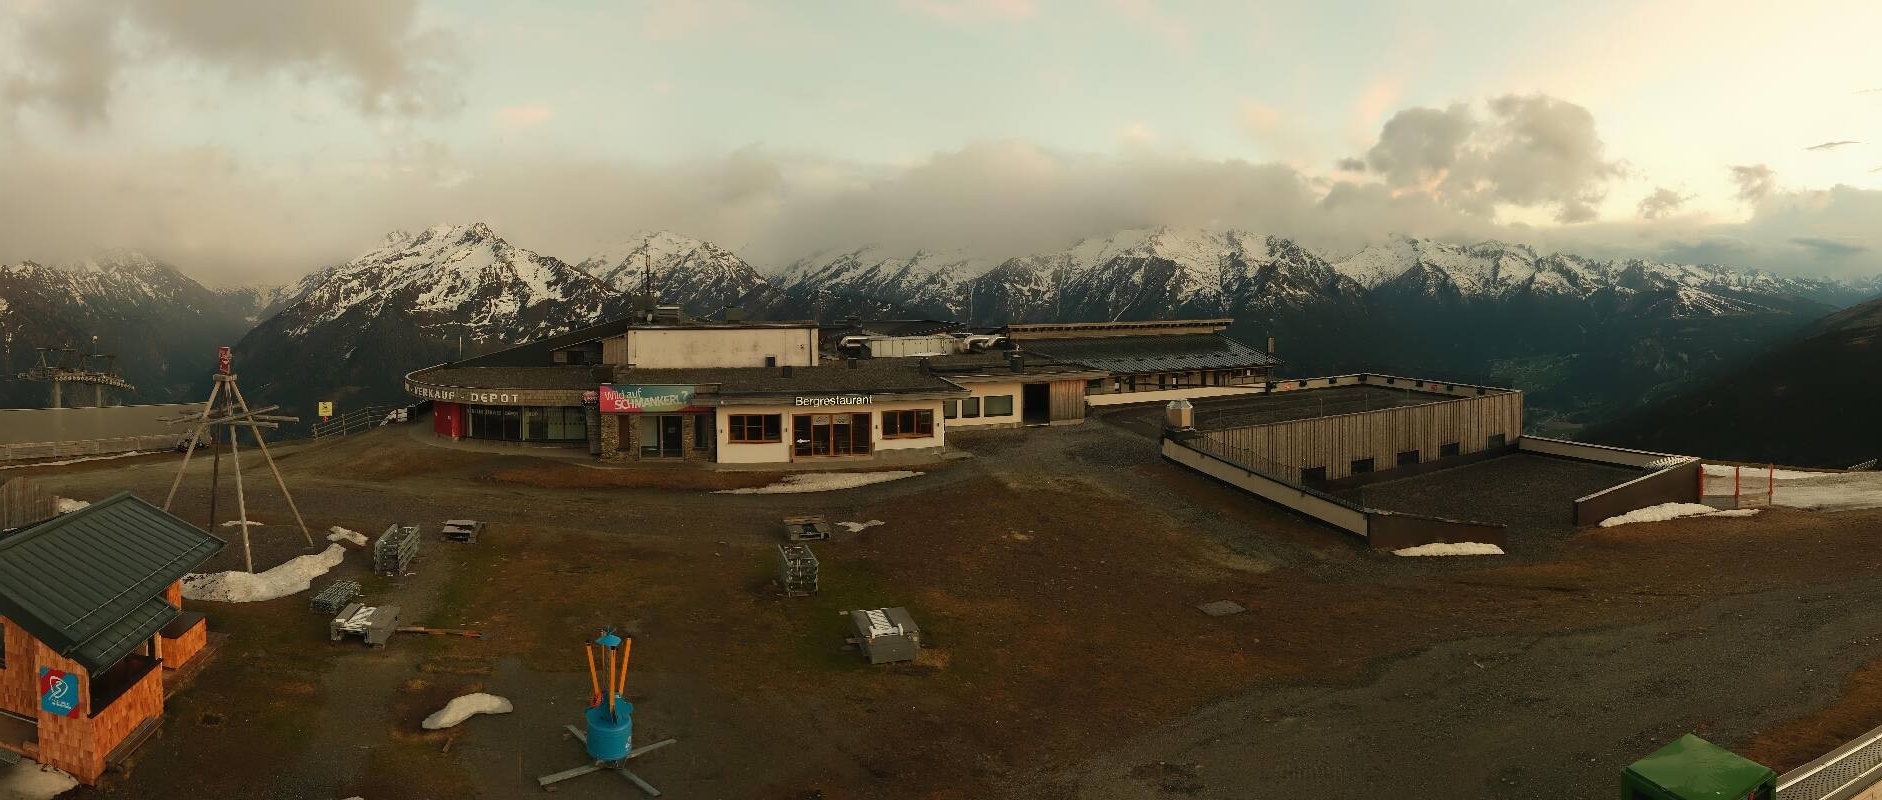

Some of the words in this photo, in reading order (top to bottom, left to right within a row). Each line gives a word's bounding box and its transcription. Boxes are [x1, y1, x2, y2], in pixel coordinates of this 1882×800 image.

[471, 393, 519, 403] DEPOT
[604, 389, 625, 401] Wild
[626, 387, 642, 399] auf
[795, 394, 873, 408] Bergrestaurant
